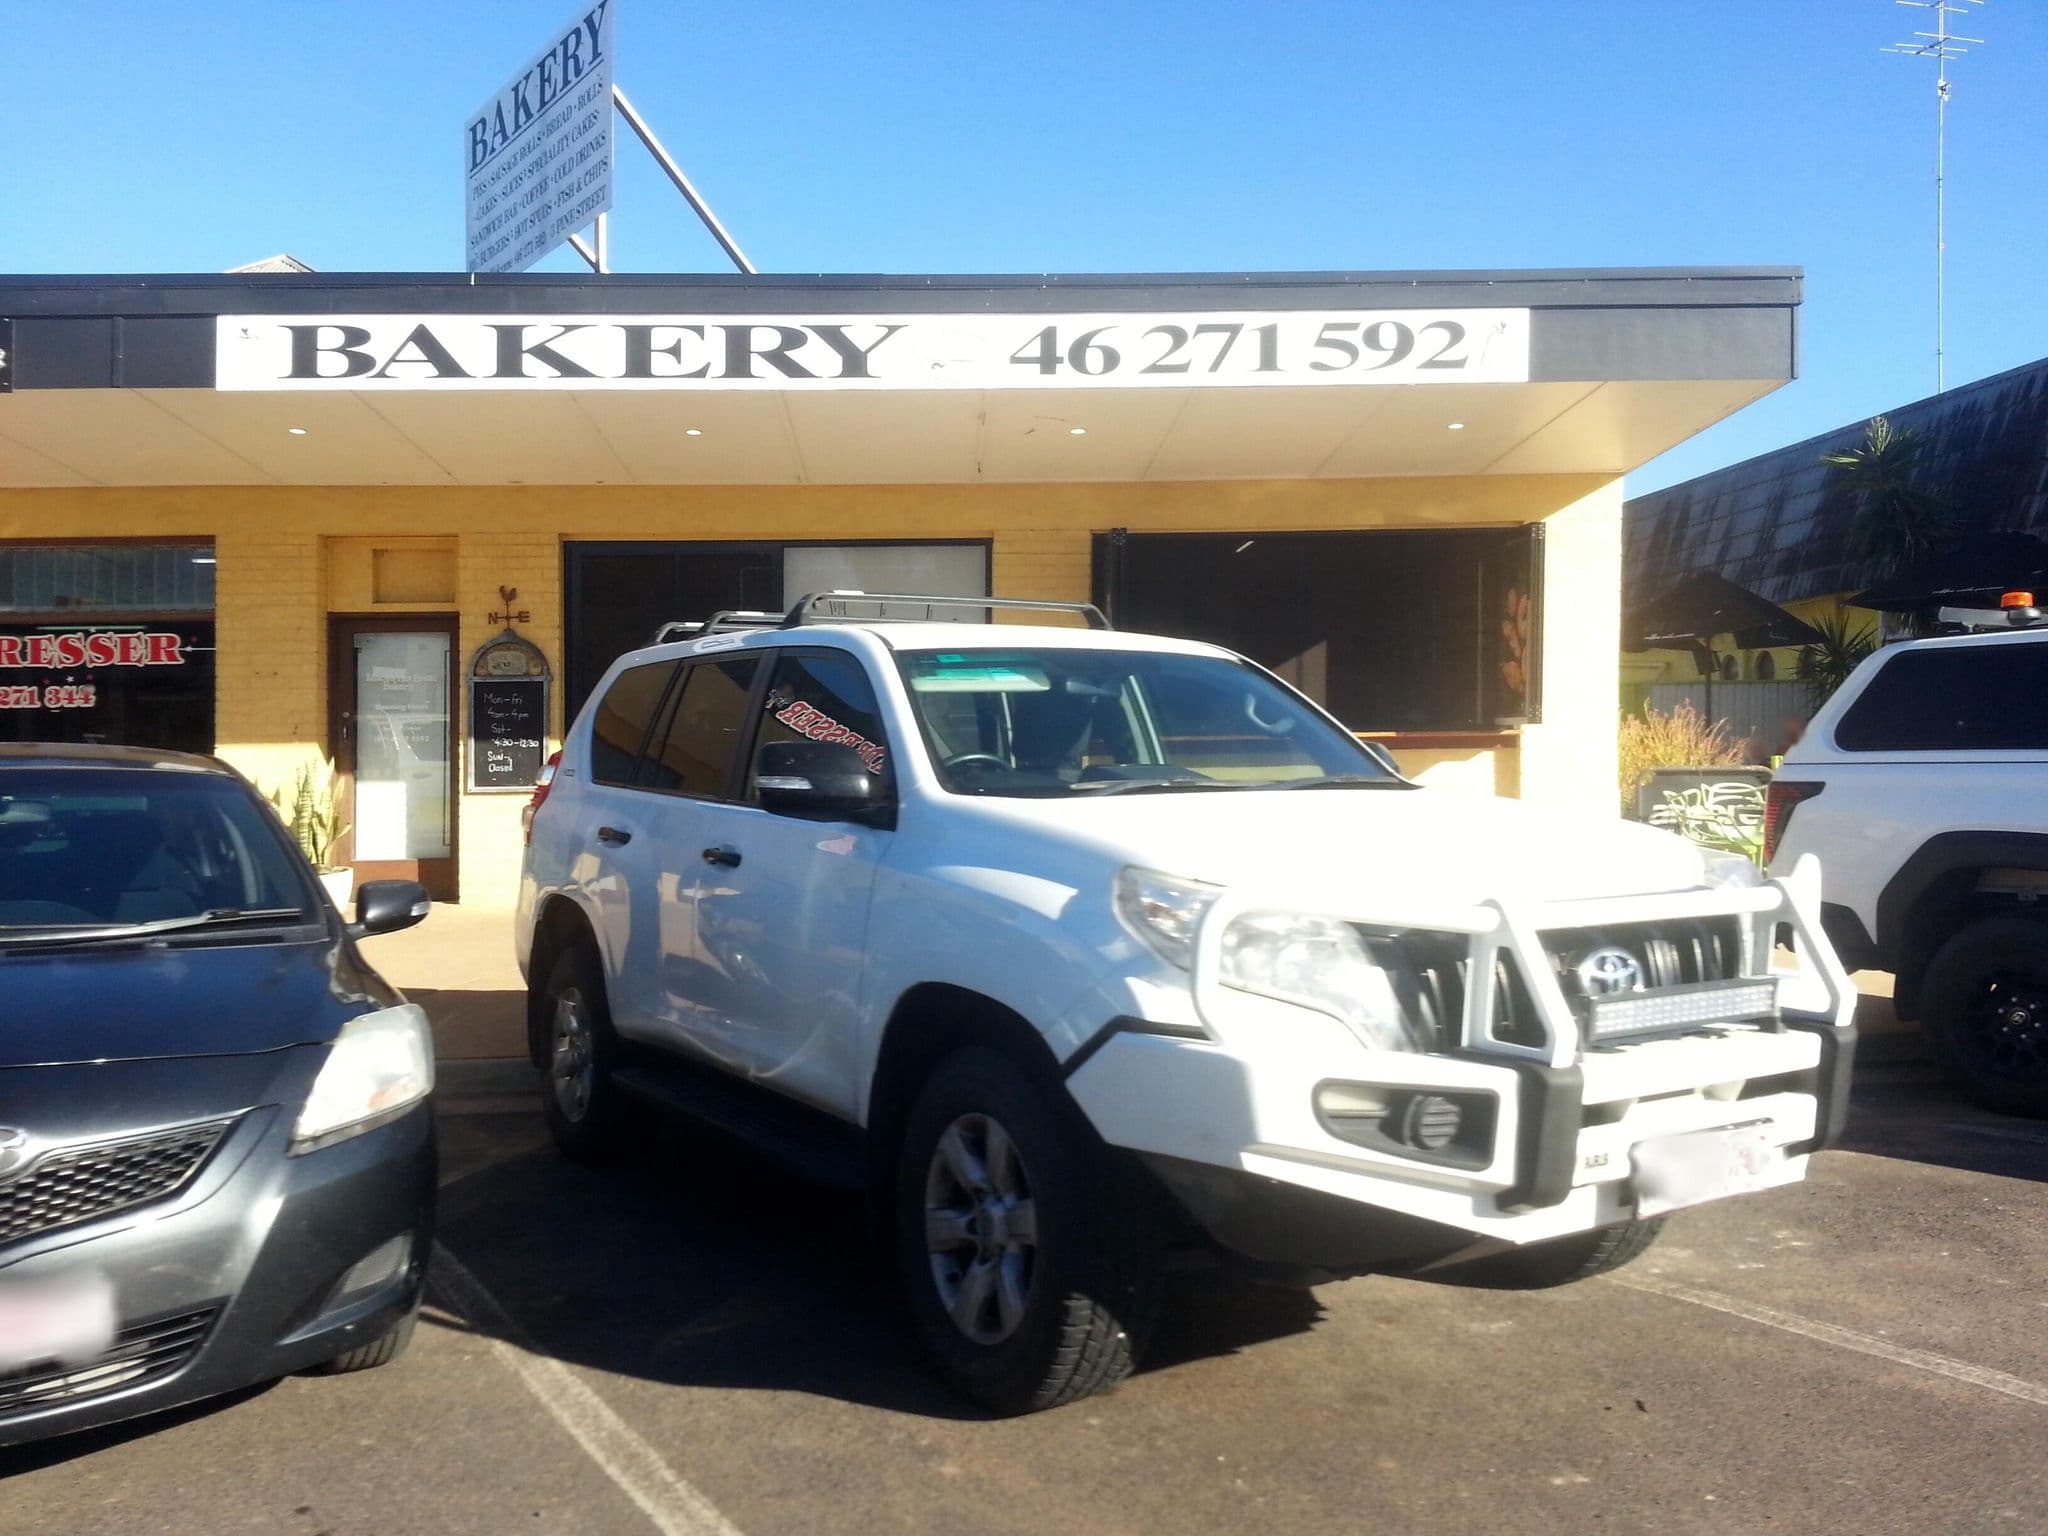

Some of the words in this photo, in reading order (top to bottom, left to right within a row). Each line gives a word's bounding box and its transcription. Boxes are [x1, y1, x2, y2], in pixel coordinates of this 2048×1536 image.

[469, 0, 608, 173] BAKERY
[546, 105, 572, 138] BREAD
[577, 78, 603, 112] ROLLS
[571, 109, 599, 142] CAKES
[521, 174, 549, 208] COFFEE
[554, 156, 573, 184] COLD
[575, 129, 606, 168] DRINKS
[557, 182, 574, 207] FISH
[576, 177, 582, 194] &
[584, 156, 608, 188] CHIPS
[556, 206, 575, 235] PINE
[575, 184, 607, 220] STREET
[278, 323, 908, 379] BAKERY
[1010, 325, 1121, 376] 46
[1138, 323, 1287, 374] 271
[1310, 320, 1469, 372] 592
[0, 632, 185, 669] RESSER
[44, 685, 96, 709] 344
